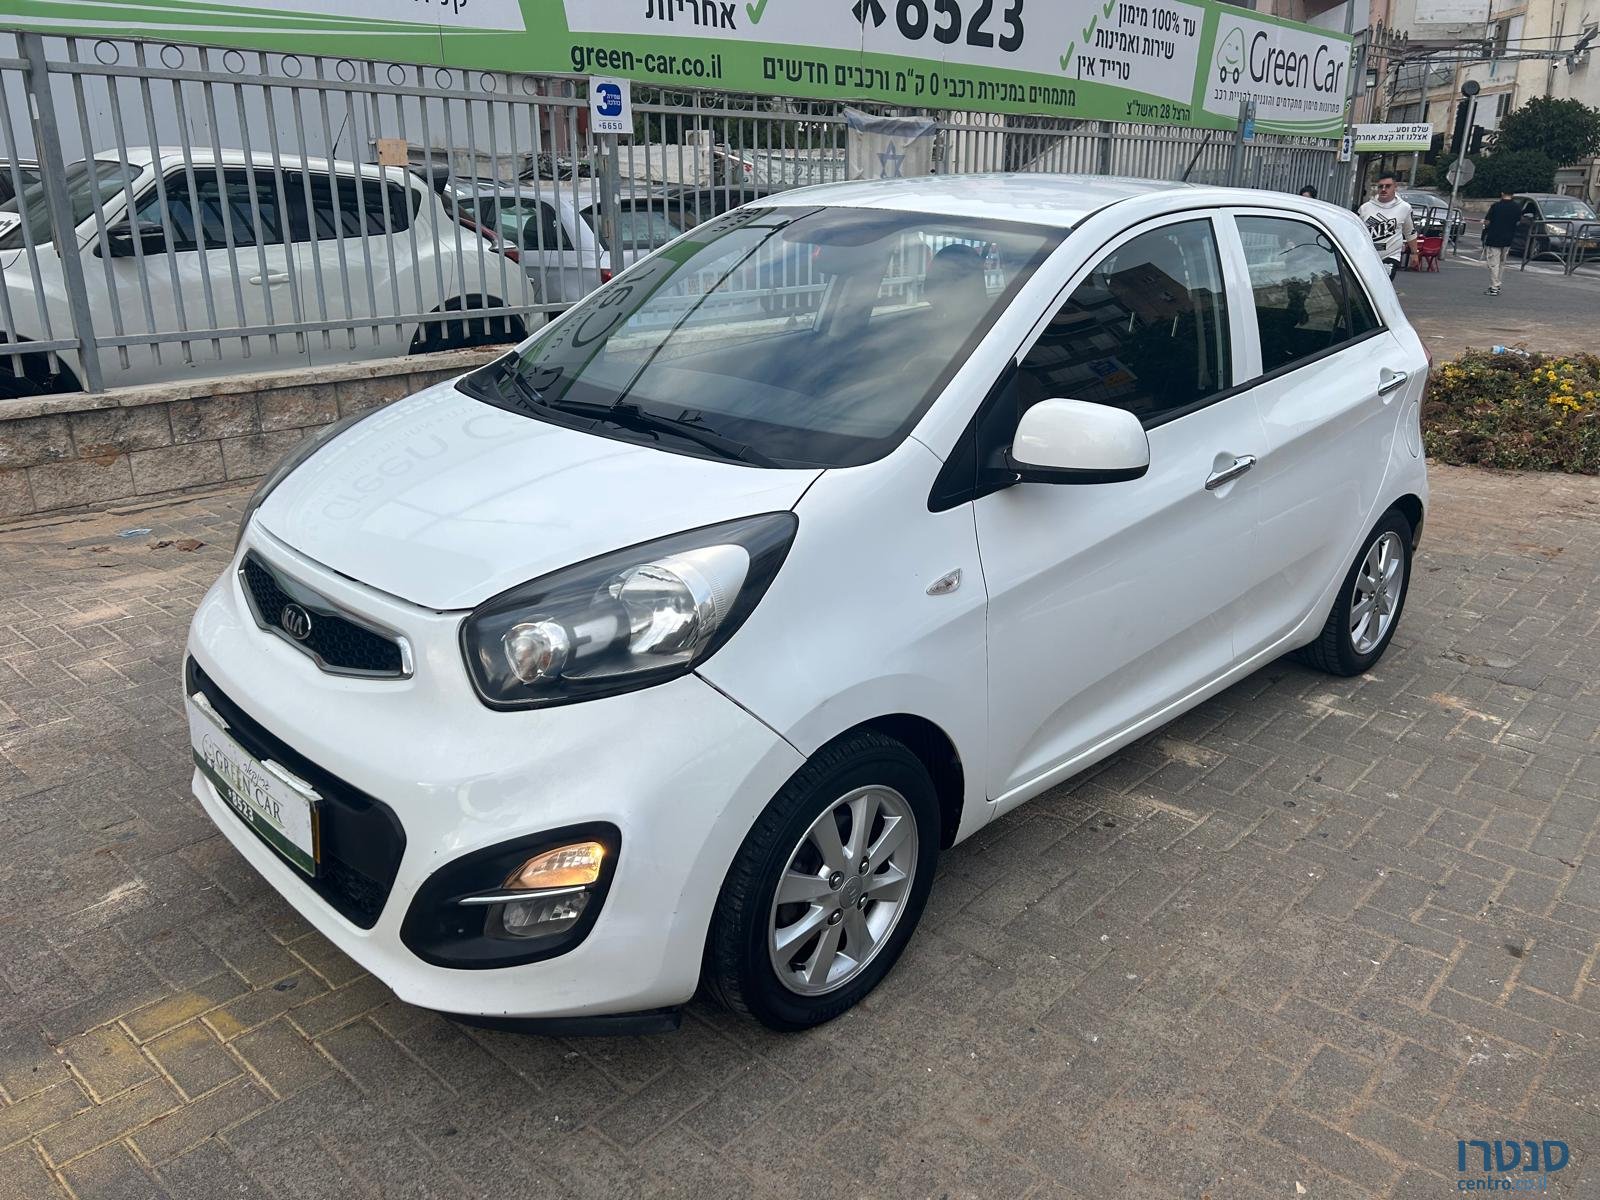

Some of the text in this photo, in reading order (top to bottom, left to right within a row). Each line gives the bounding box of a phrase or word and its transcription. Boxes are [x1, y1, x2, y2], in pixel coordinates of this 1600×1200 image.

[645, 0, 736, 30] אחריות
[1118, 3, 1196, 37] עד 100% מימון
[1096, 29, 1175, 59] שירות ואמינות
[571, 45, 721, 79] green-car.co.il
[763, 57, 828, 84] חדשים
[1077, 55, 1130, 80] טרייד אין
[1249, 30, 1344, 94] Green Car
[835, 65, 889, 90] ורכבים
[930, 72, 939, 95] 0
[943, 78, 974, 98] רכבי
[977, 81, 1025, 102] במכירת
[1029, 85, 1076, 106] מתמחים
[1214, 88, 1227, 100] רכב
[1160, 103, 1171, 119] 28
[1172, 105, 1191, 121] הרצל
[1377, 134, 1394, 142] קצת
[1411, 125, 1429, 133] שלם
[255, 788, 283, 823] CAR
